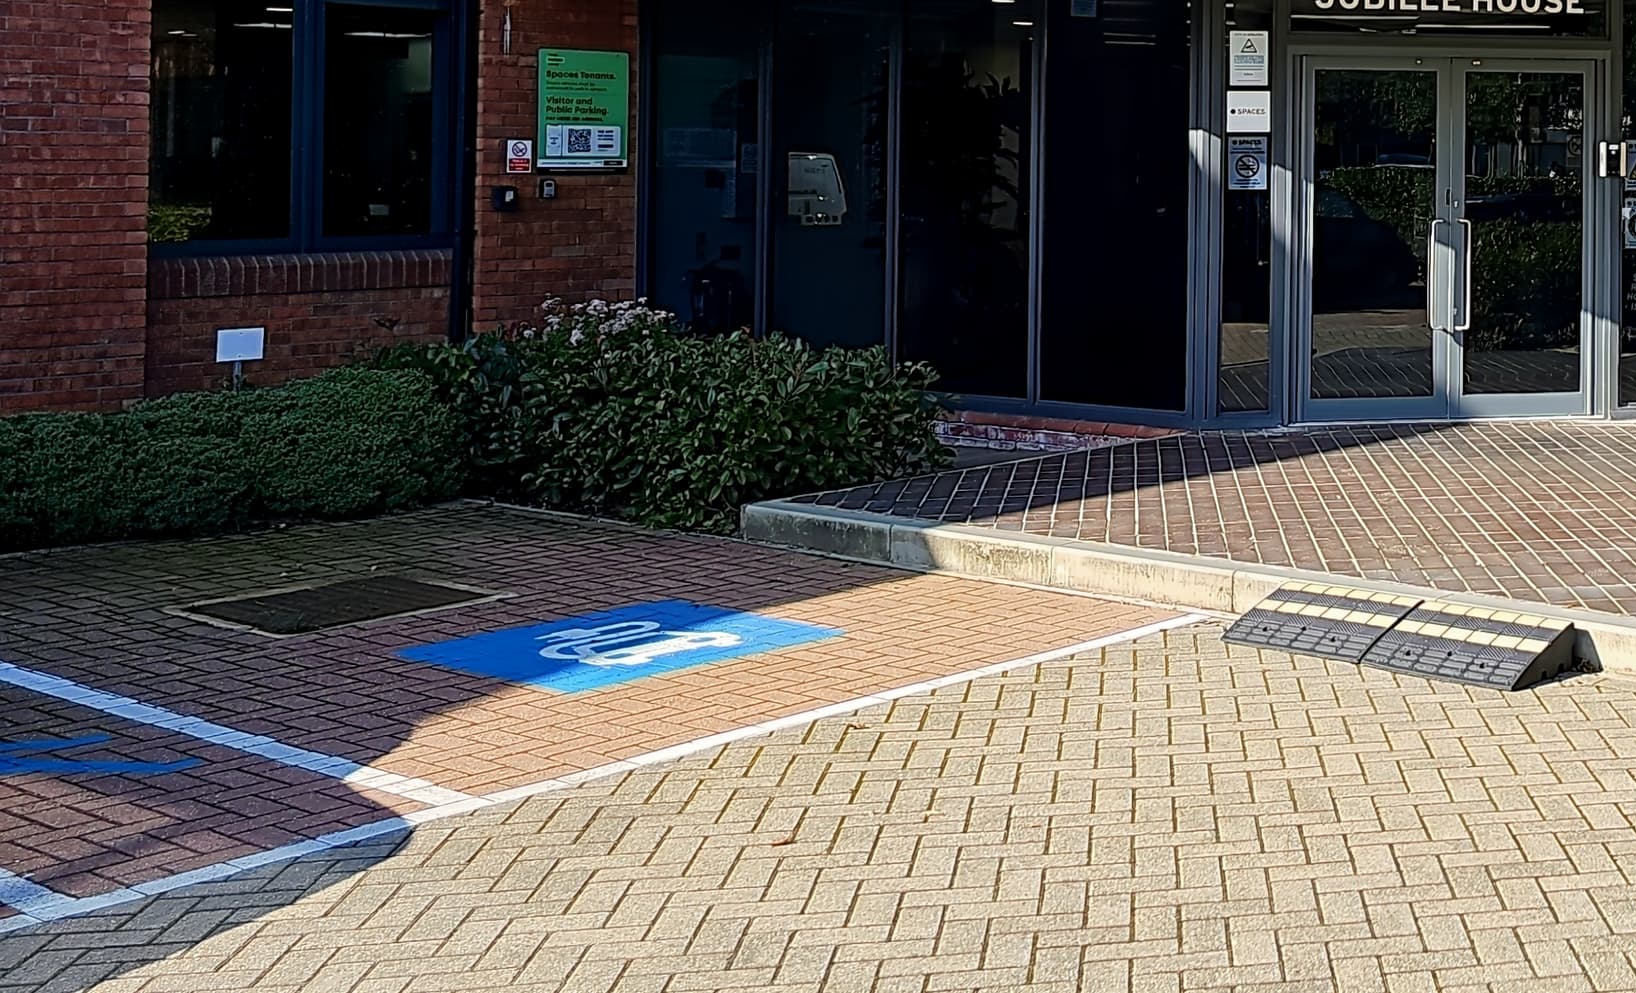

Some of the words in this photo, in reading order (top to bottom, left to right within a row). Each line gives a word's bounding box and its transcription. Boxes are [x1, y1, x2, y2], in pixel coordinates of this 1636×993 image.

[546, 70, 578, 79] Spaces
[545, 96, 574, 105] Visitor
[575, 97, 593, 105] and
[545, 105, 573, 114] Public
